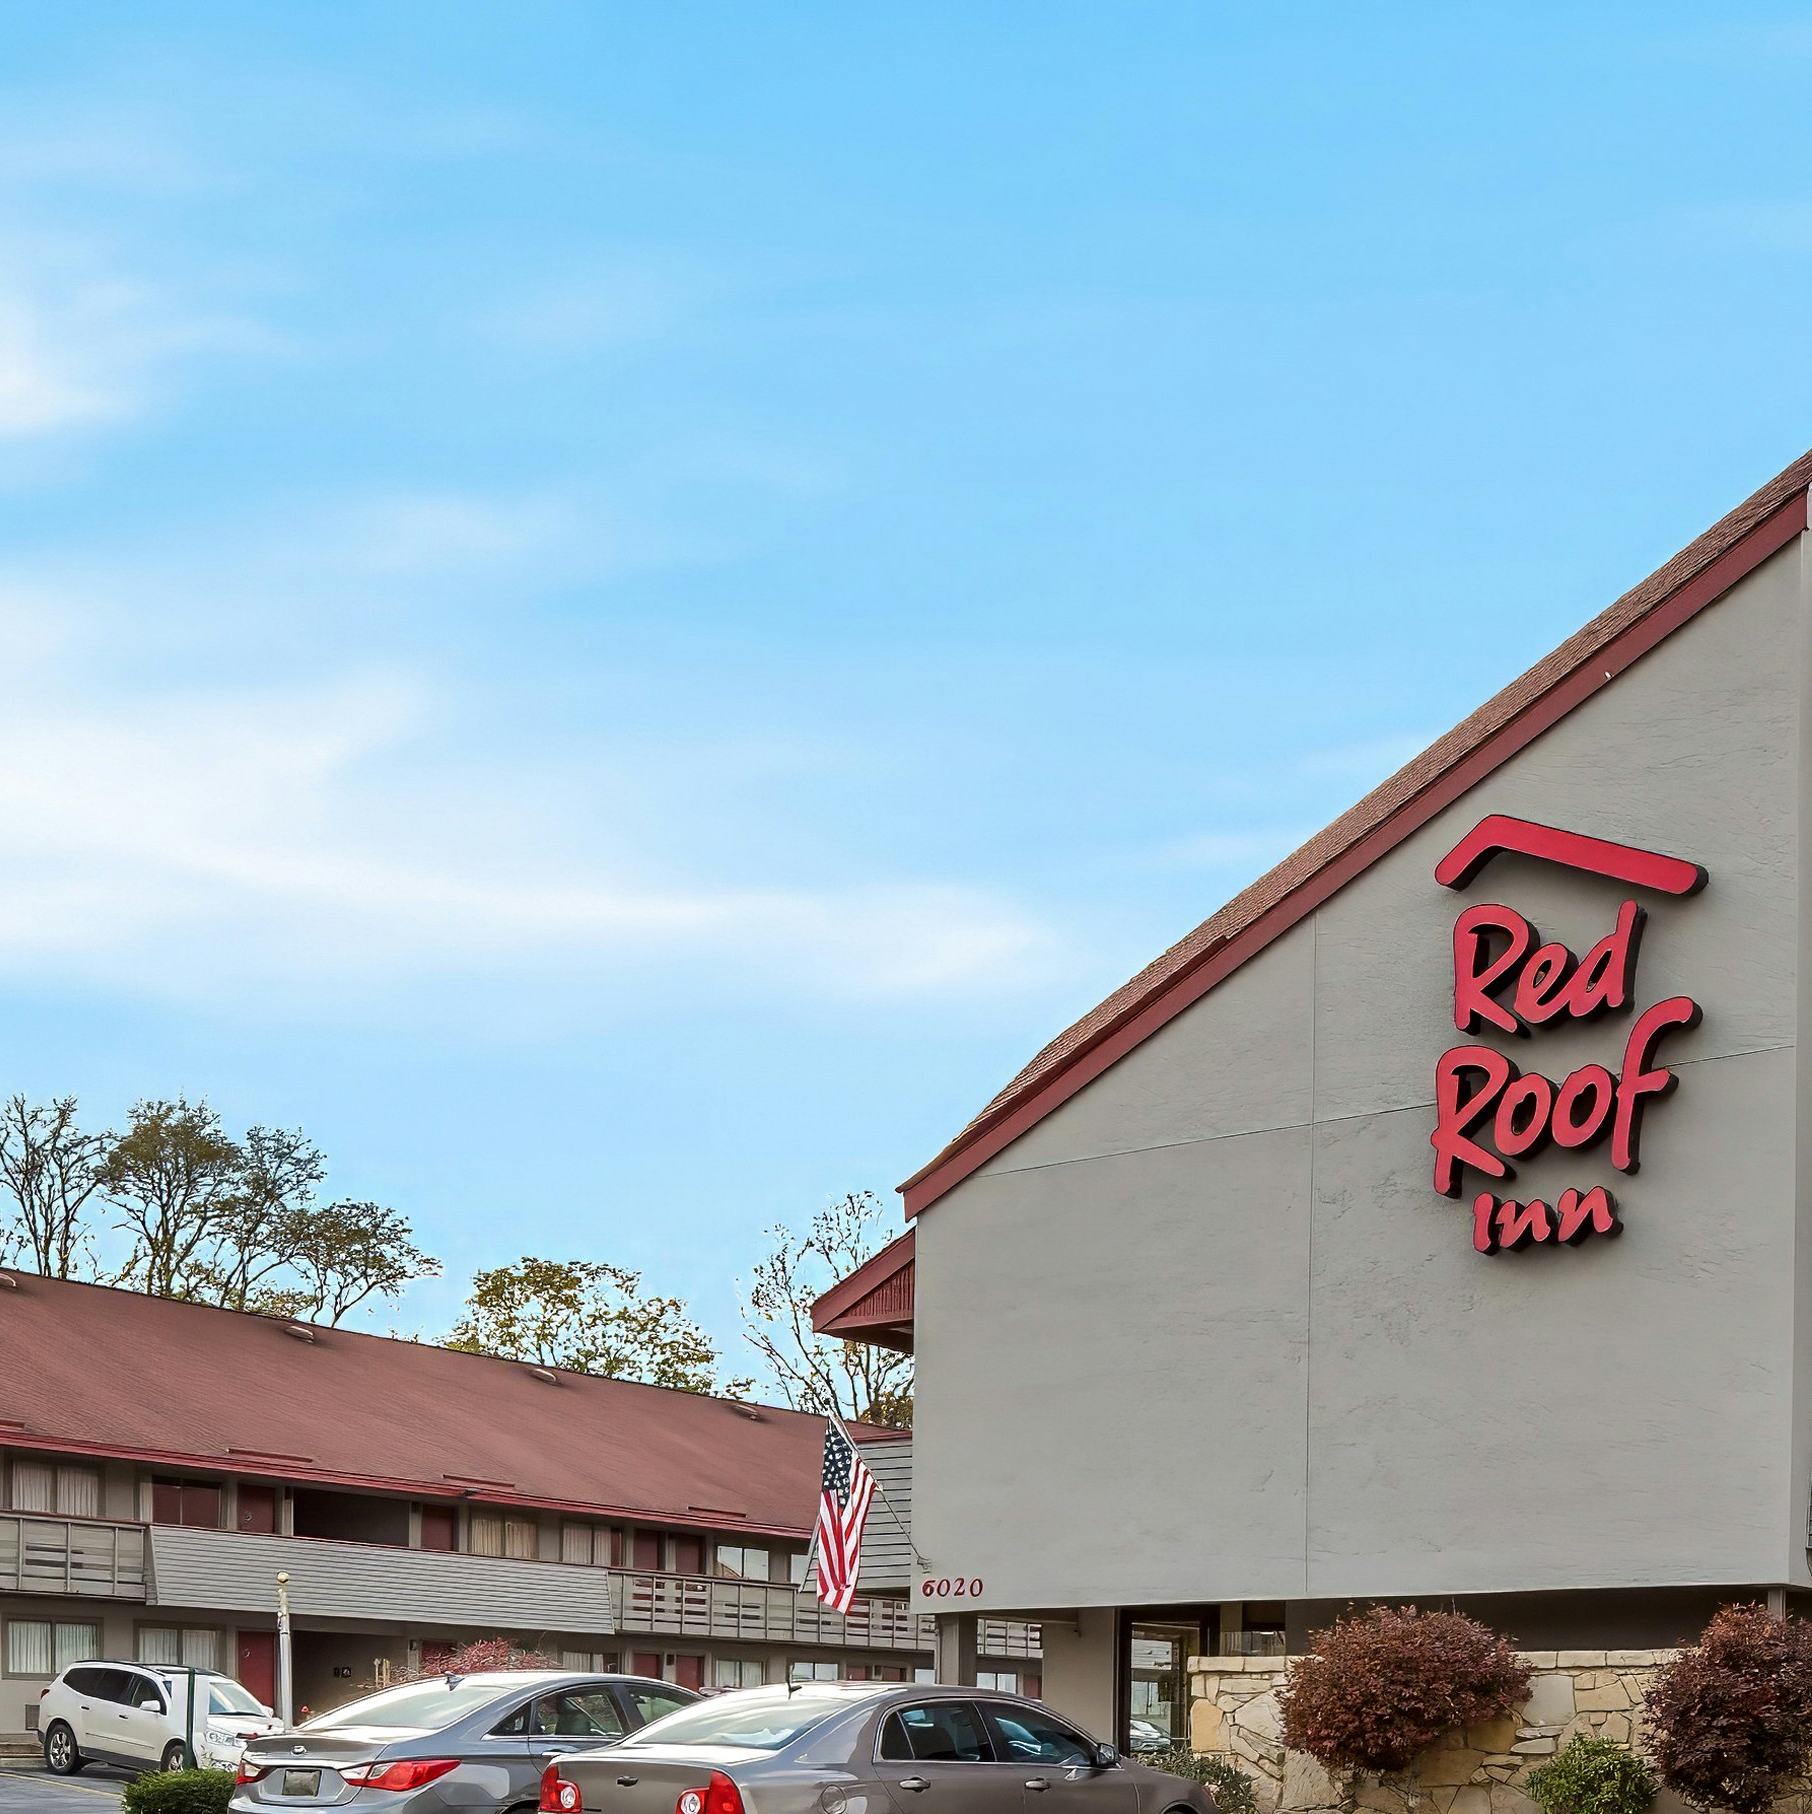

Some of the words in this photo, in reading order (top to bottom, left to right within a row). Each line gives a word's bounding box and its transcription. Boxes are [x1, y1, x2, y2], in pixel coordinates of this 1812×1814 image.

[1453, 899, 1647, 1037] Red
[1430, 996, 1703, 1198] Roof
[922, 1577, 984, 1598] 6020
